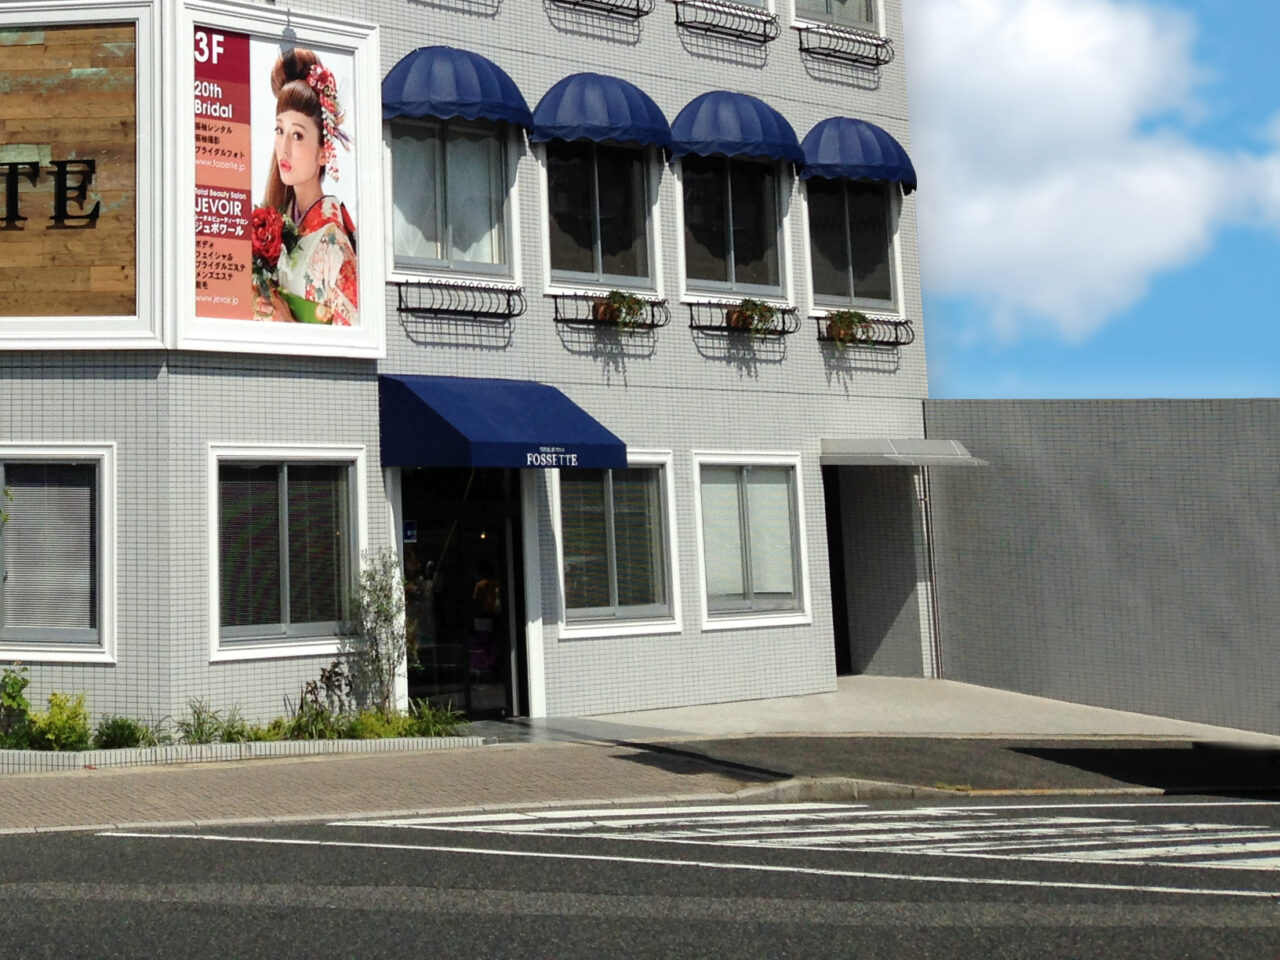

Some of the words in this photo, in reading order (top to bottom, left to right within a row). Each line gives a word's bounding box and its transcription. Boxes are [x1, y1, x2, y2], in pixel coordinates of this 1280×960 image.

[194, 31, 224, 65] 3F
[194, 80, 222, 99] 20th
[194, 99, 232, 118] Bridal
[209, 189, 229, 199] Beauty
[230, 191, 247, 200] Salon
[194, 197, 242, 216] JEVOIR
[526, 452, 578, 467] FOSSETTE
